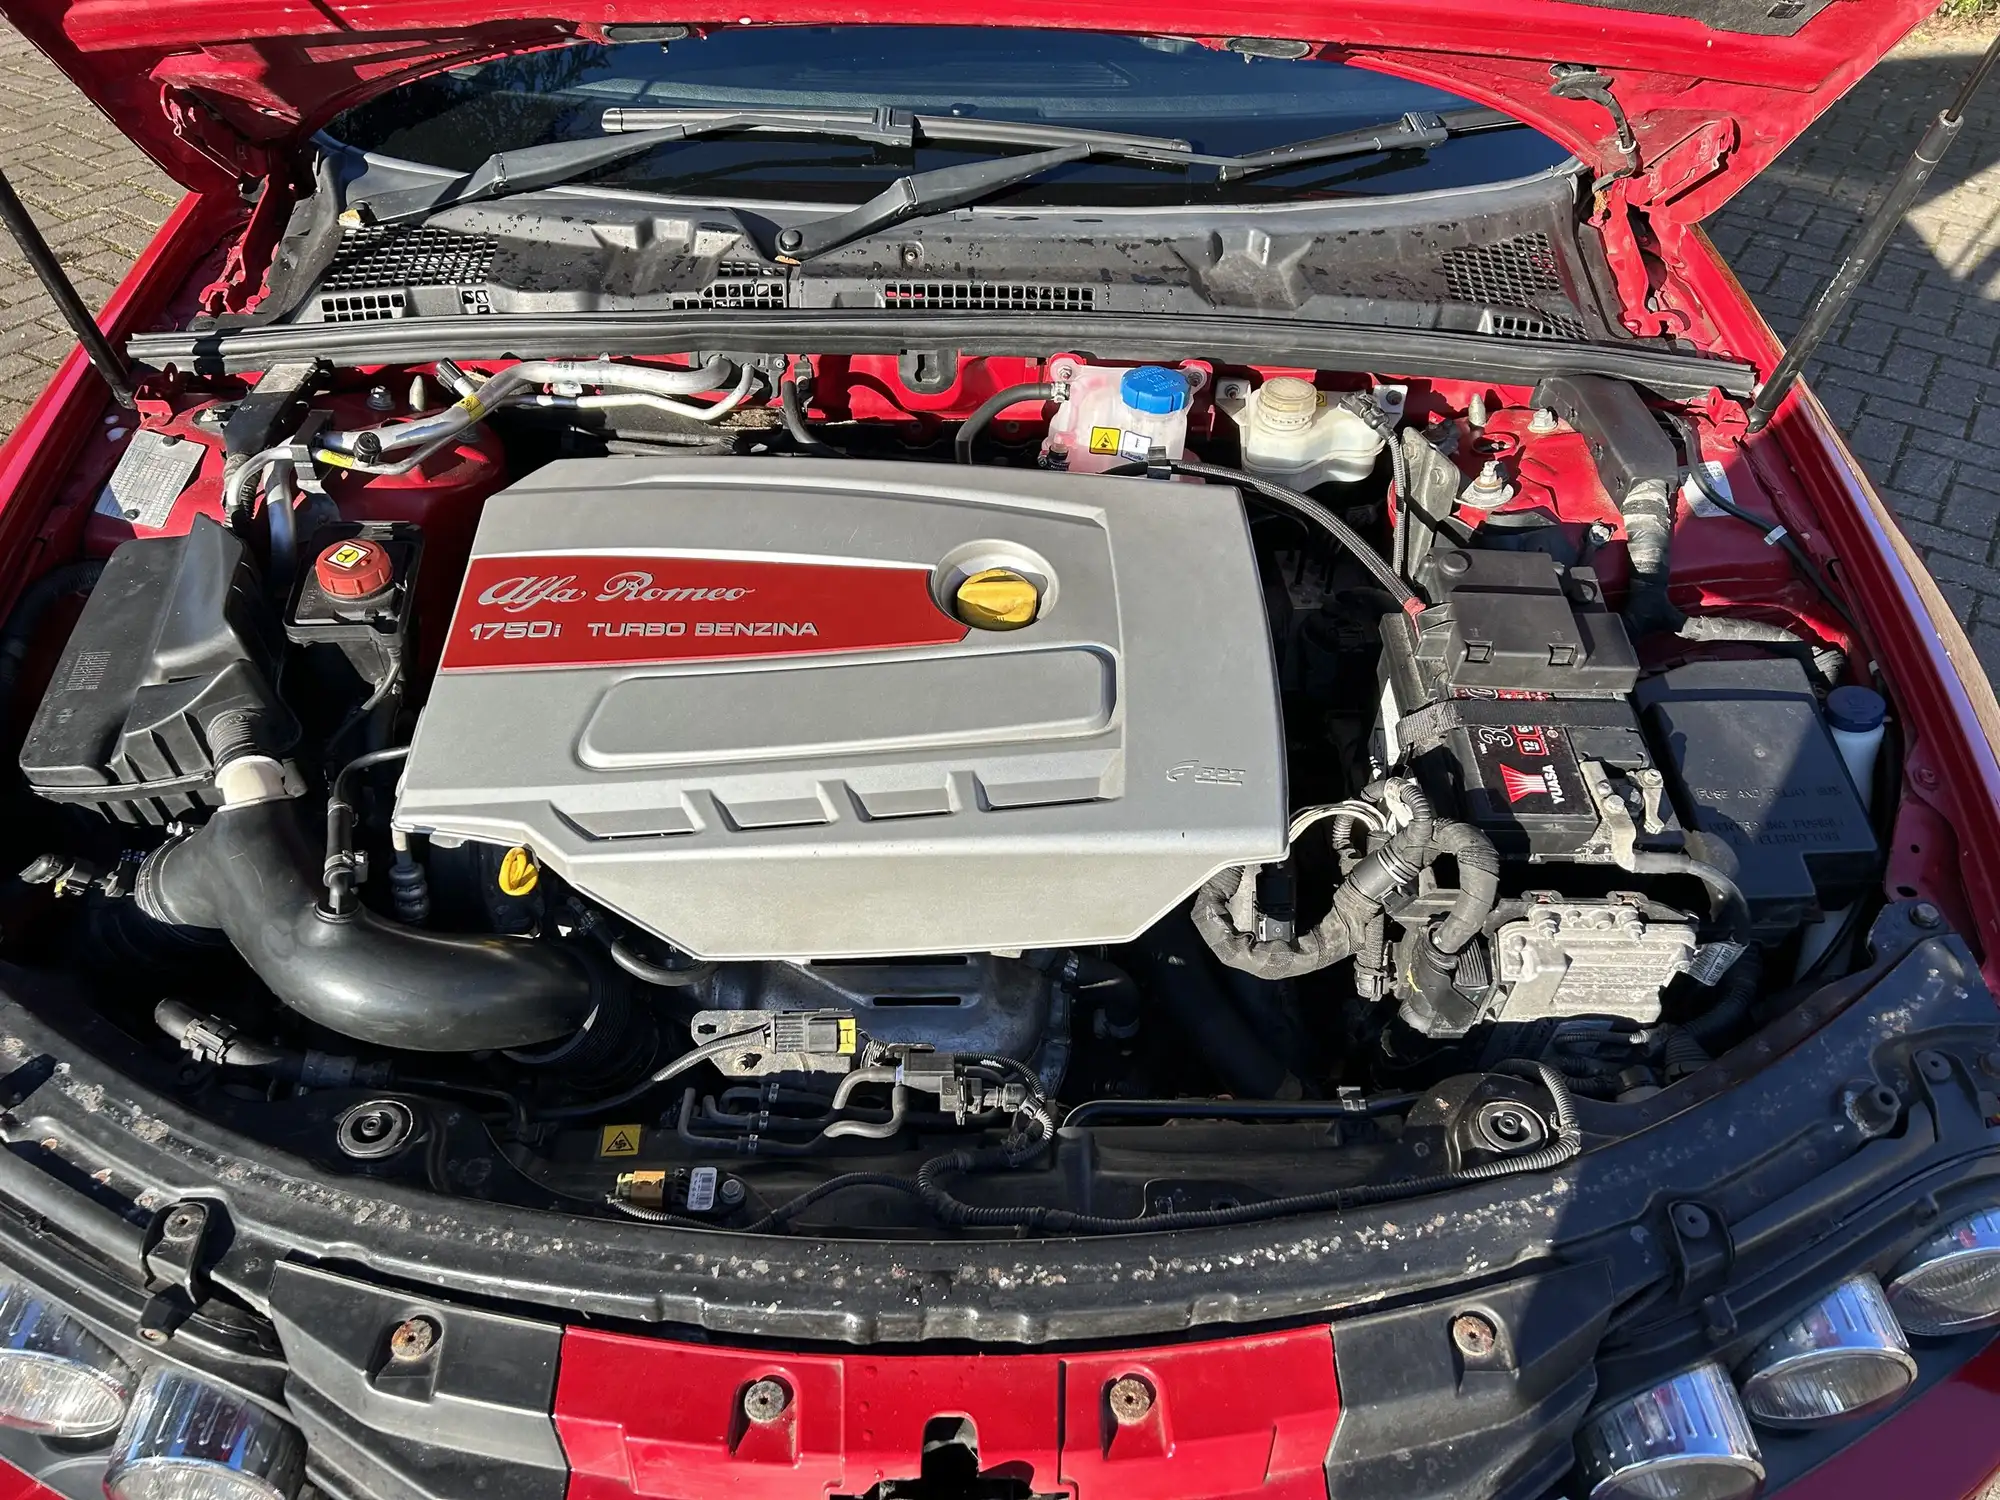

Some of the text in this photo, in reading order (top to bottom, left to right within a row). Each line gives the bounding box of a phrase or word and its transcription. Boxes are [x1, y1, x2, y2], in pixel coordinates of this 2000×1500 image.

[478, 571, 755, 613] Alfa Romeo
[469, 621, 819, 640] 1750i TURBO BENZINA
[1542, 764, 1565, 804] YUASA
[1695, 787, 1730, 800] FUSE
[1737, 788, 1760, 799] AND
